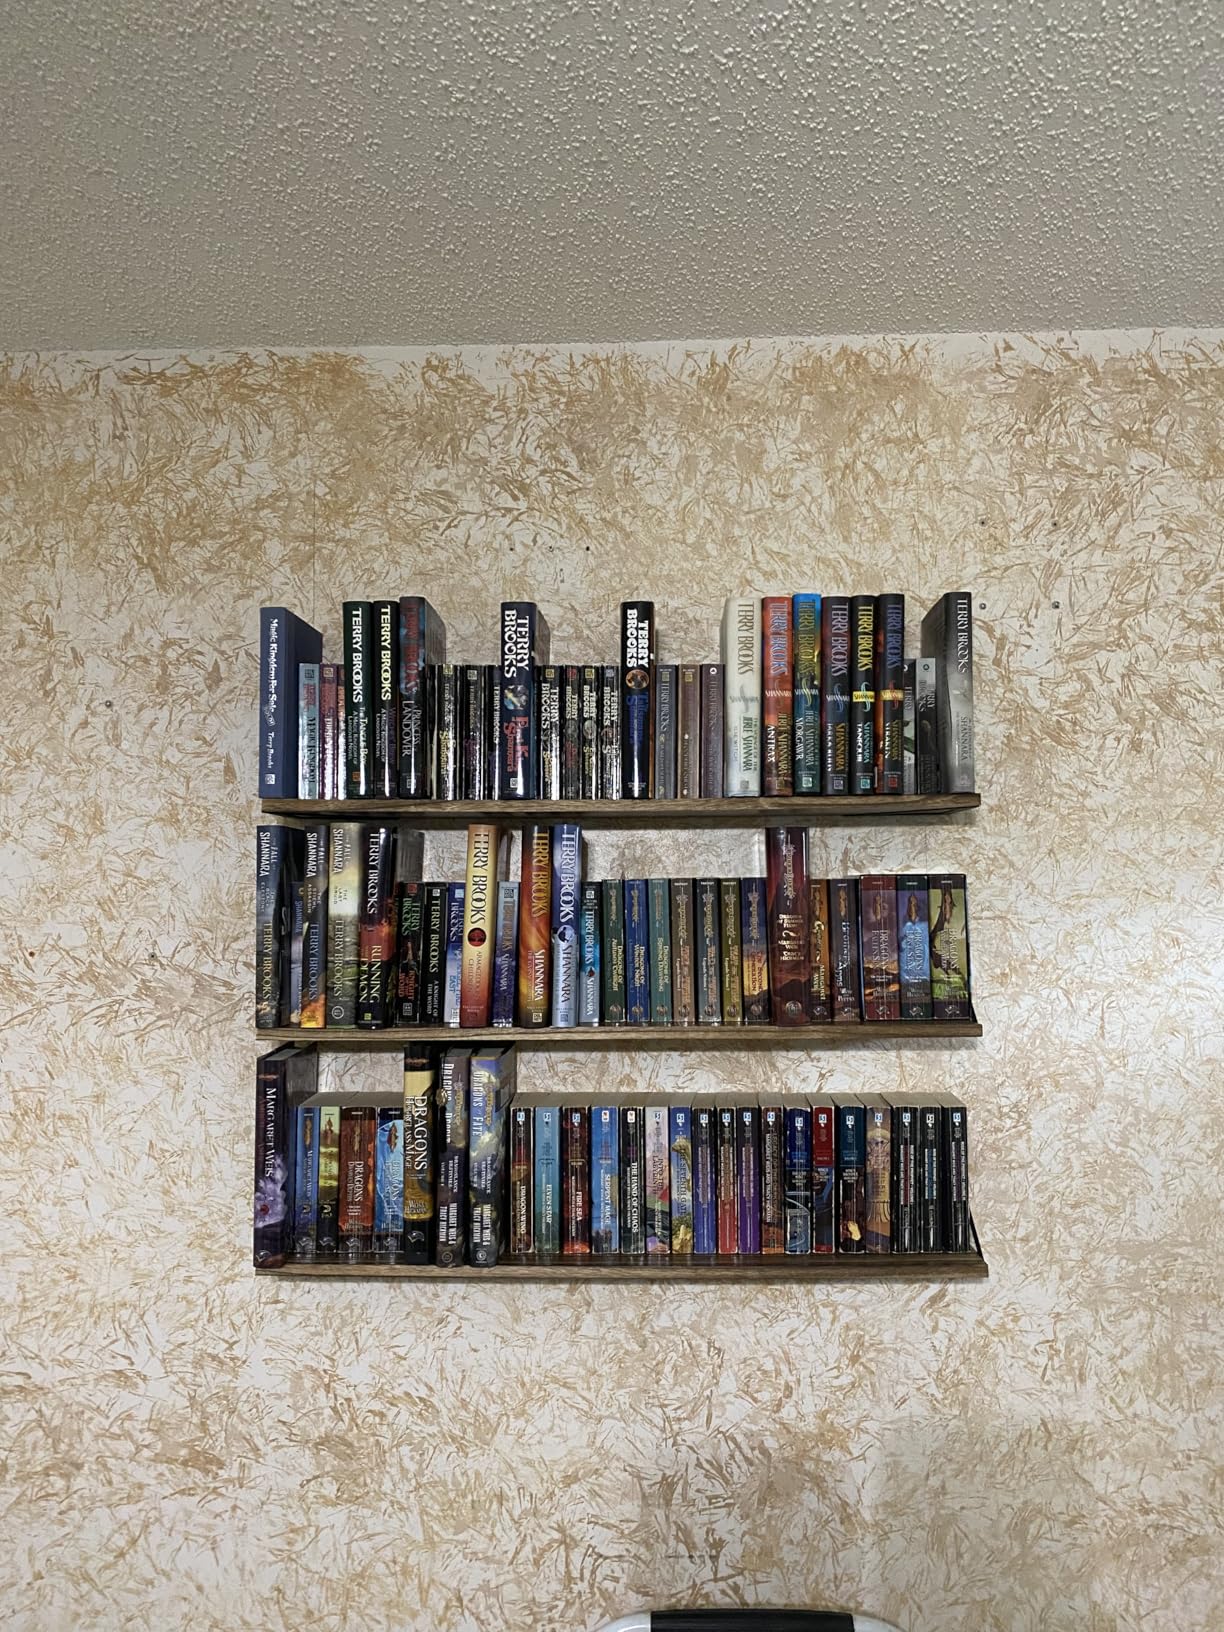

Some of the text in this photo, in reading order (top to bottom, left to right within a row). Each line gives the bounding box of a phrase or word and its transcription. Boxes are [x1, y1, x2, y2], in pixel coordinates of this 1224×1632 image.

[269, 619, 278, 642] Magic
[381, 606, 391, 700] TERRY BROOKS
[402, 604, 419, 691] TERRY BROOKS
[504, 610, 517, 678] BROOKS
[517, 616, 529, 670] TERRY
[626, 609, 637, 667] BROOKS
[638, 620, 649, 667] TERRY
[738, 602, 754, 675] TERRY BROOKS
[770, 601, 788, 676] TERRY BROOKS
[798, 602, 816, 673] TERRY BROOKS
[832, 603, 848, 676] TERRY BROOKS
[858, 605, 873, 671] TERRY BROOKS
[887, 603, 901, 668] TERRY BROOKS
[957, 599, 969, 673] TERRY BROOKS
[268, 644, 278, 679] Kingdom
[352, 608, 362, 703] TERRY BROOKS
[268, 694, 278, 712] Sale
[541, 683, 550, 729] BROOKS
[550, 686, 559, 723] TERRY
[660, 682, 670, 731] TERRY BROOKS
[266, 732, 274, 748] Terry
[308, 717, 316, 744] MAGIC
[402, 700, 414, 757] LANDOVER
[412, 709, 422, 745] PRINCESS
[504, 722, 517, 772] Shannara
[743, 717, 753, 772] JERLE SHANNARA
[767, 724, 775, 762] ANTRAX
[795, 717, 804, 760] MORGAWR
[805, 729, 815, 766] SHANNARA
[835, 723, 845, 771] SHANNARA
[960, 716, 968, 761] SHANNARA
[306, 745, 316, 783] KINGDOM
[778, 733, 788, 776] SHANNARA
[259, 832, 271, 876] SHANNARA
[306, 833, 317, 877] SHANNARA
[333, 829, 344, 873] SHANNARA
[367, 832, 380, 914] TERRY BROOKS
[532, 832, 548, 917] TERRY BROOKS
[470, 832, 490, 924] TERRY BROOKS
[560, 833, 576, 922] TERRY BROOKS
[402, 898, 412, 936] BROOKS
[411, 902, 421, 931] TERRY
[429, 899, 440, 973] TERRY BROOKS
[450, 902, 459, 941] BROOKS
[585, 911, 594, 964] TERRY BROOKS
[262, 920, 273, 999] TERRY BROOKS
[309, 923, 319, 1000] TERRY BROOKS
[334, 920, 344, 996] TERRY BROOKS
[500, 953, 510, 990] SHANNARA
[880, 930, 888, 969] DRAGONS
[914, 930, 922, 970] DRAGONS
[949, 929, 959, 969] DRAGONS
[358, 958, 368, 1003] DEMON
[370, 945, 382, 1003] RUNNING
[407, 970, 416, 1000] KNIGHT
[535, 950, 545, 1000] SHANNARA
[561, 944, 573, 1003] SHANNARA
[472, 1072, 484, 1136] DRAGONS FATE
[265, 1088, 277, 1177] MARGARET WEIS
[405, 1096, 413, 1169] HOURGLASS MAGE
[414, 1096, 427, 1170] DRAGONS
[355, 1161, 364, 1201] DRAGONS
[391, 1160, 400, 1200] DRAGONS
[631, 1197, 638, 1206] OF
[440, 1222, 448, 1242] HICKMAN
[473, 1207, 481, 1242] TRACY HICKMAN
[483, 1204, 491, 1228] MARGARET
[483, 1229, 491, 1240] WEIS
